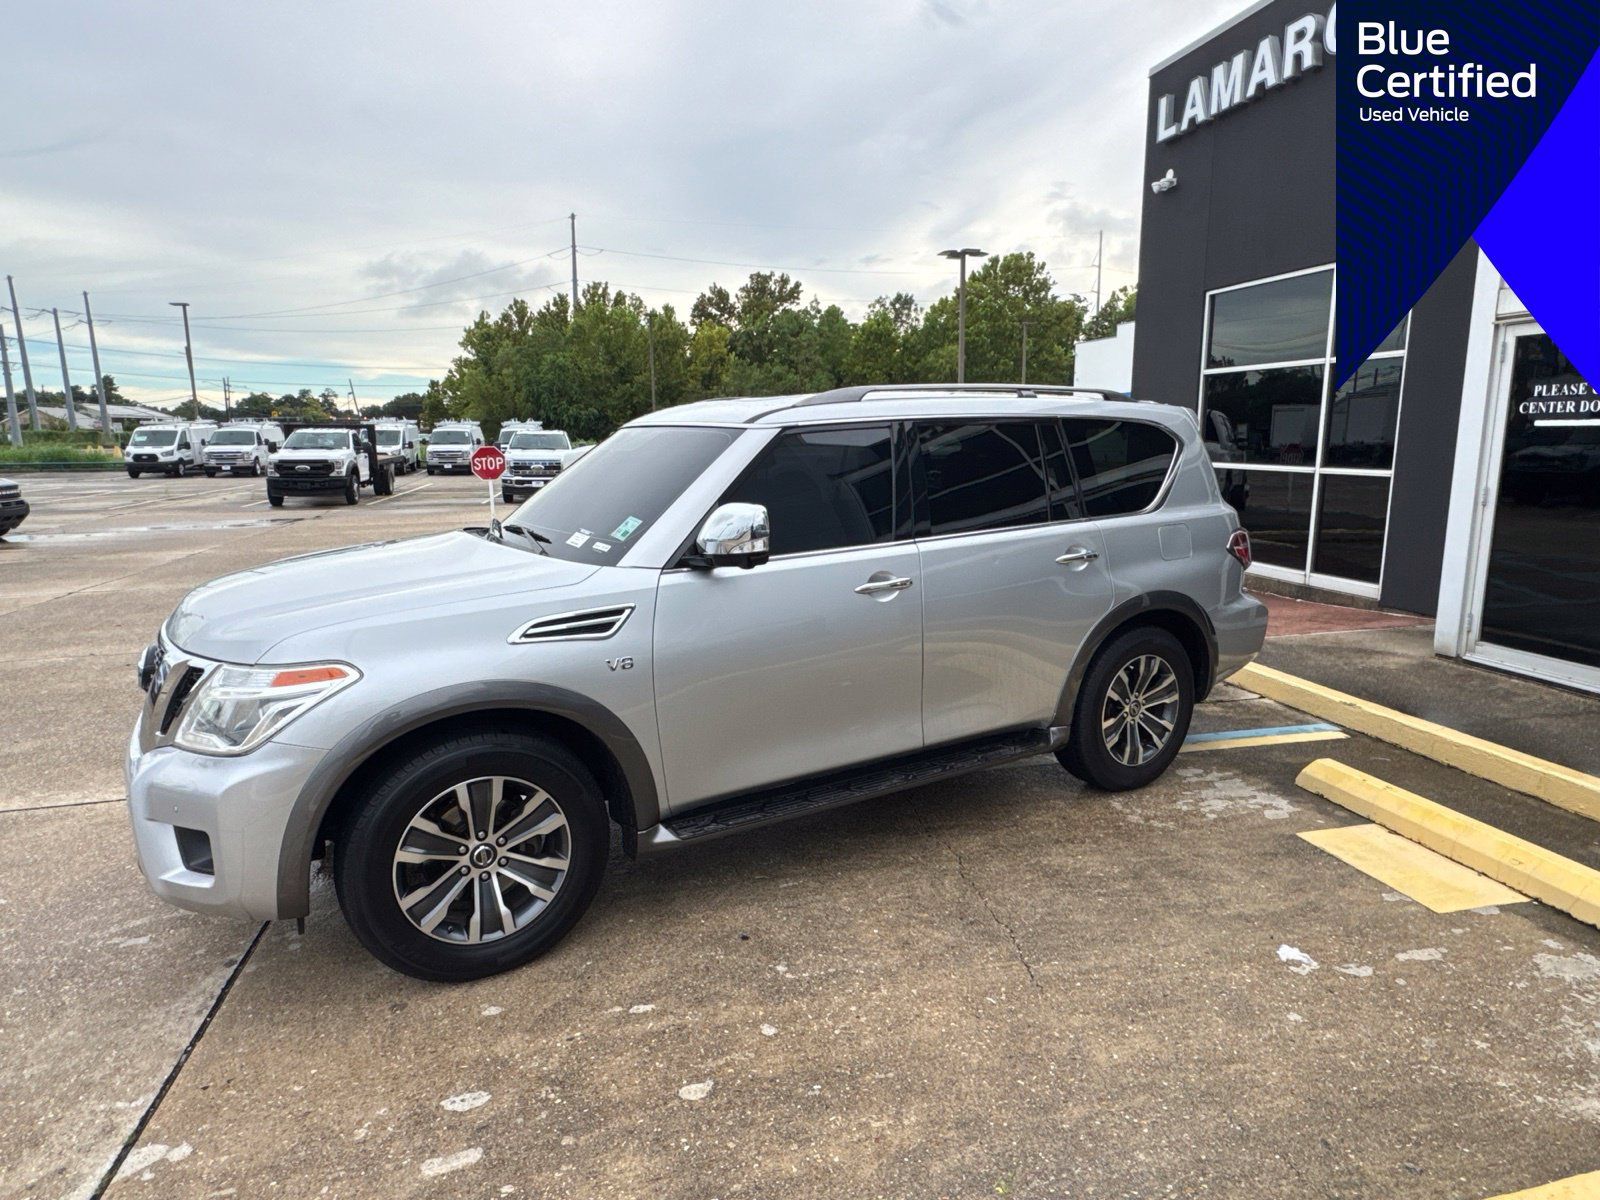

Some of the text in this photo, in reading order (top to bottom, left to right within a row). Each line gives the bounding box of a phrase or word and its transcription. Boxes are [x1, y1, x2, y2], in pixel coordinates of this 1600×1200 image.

[1533, 382, 1588, 397] PLEASE
[1519, 400, 1575, 414] CENTER
[473, 457, 504, 471] STOP
[605, 655, 634, 671] V8
